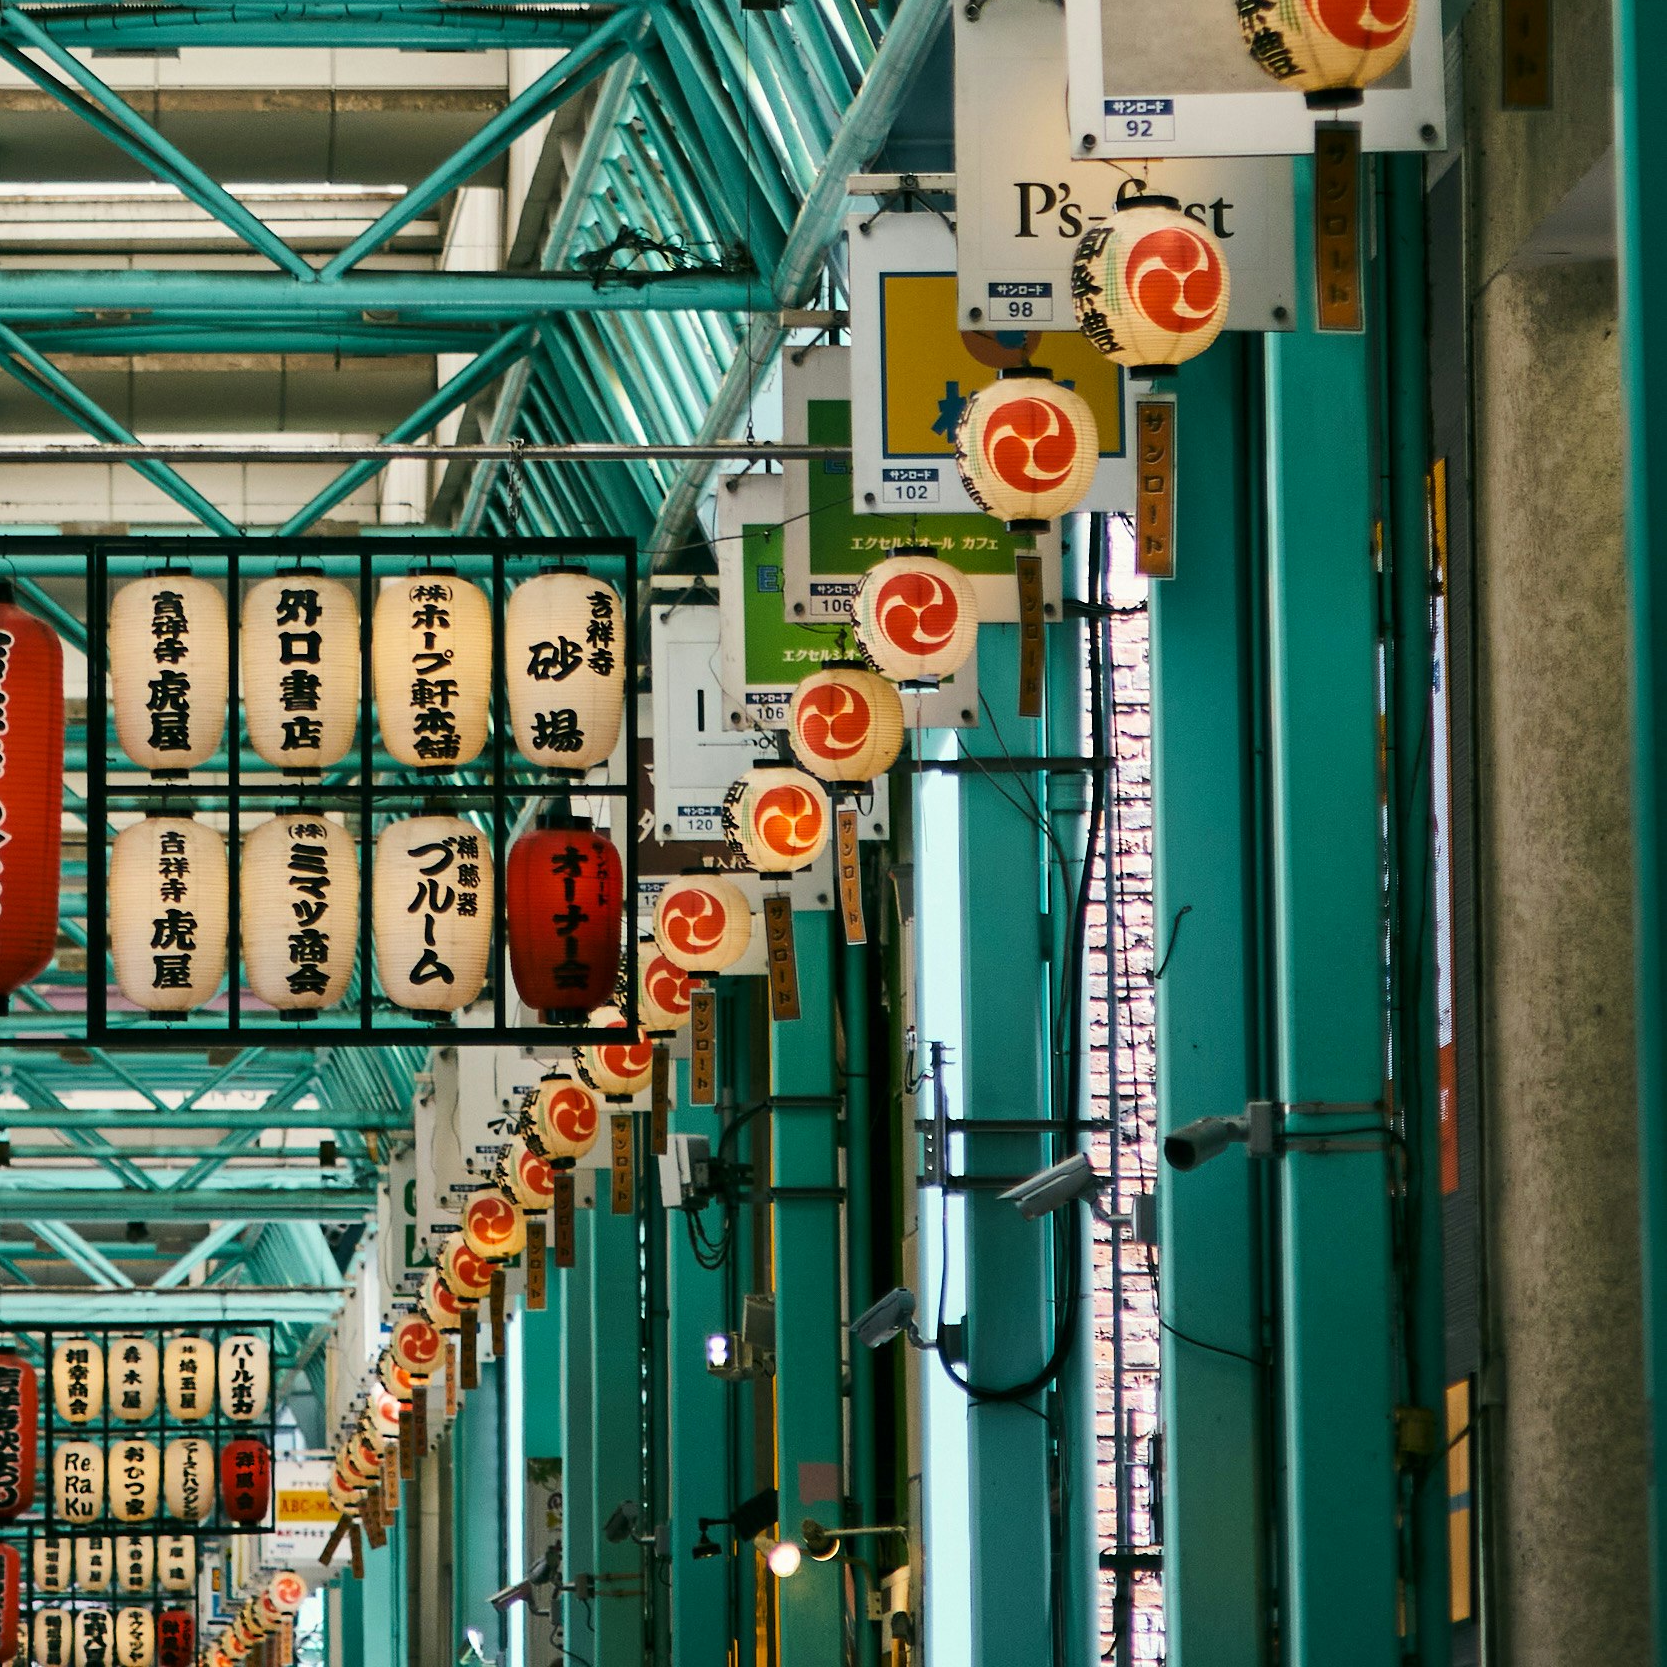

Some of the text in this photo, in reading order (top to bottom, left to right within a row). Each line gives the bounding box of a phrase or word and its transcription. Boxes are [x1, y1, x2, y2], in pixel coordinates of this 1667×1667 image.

[1111, 101, 1166, 115] サンロード
[1125, 119, 1154, 138] 92
[996, 284, 1045, 296] サンロード
[1008, 301, 1034, 319] 98
[888, 469, 933, 481] サンロード
[894, 485, 929, 501] 102
[962, 537, 999, 551] カフェ
[822, 598, 853, 613] 106
[584, 589, 616, 678] 吉祥寺
[276, 588, 324, 751] 外口書店
[526, 633, 586, 754] 砂場
[756, 706, 785, 720] 106
[682, 806, 717, 817] サンロード
[687, 819, 714, 831] 120
[287, 823, 332, 997] (株)ミマツ商会
[64, 1497, 93, 1517] Ku
